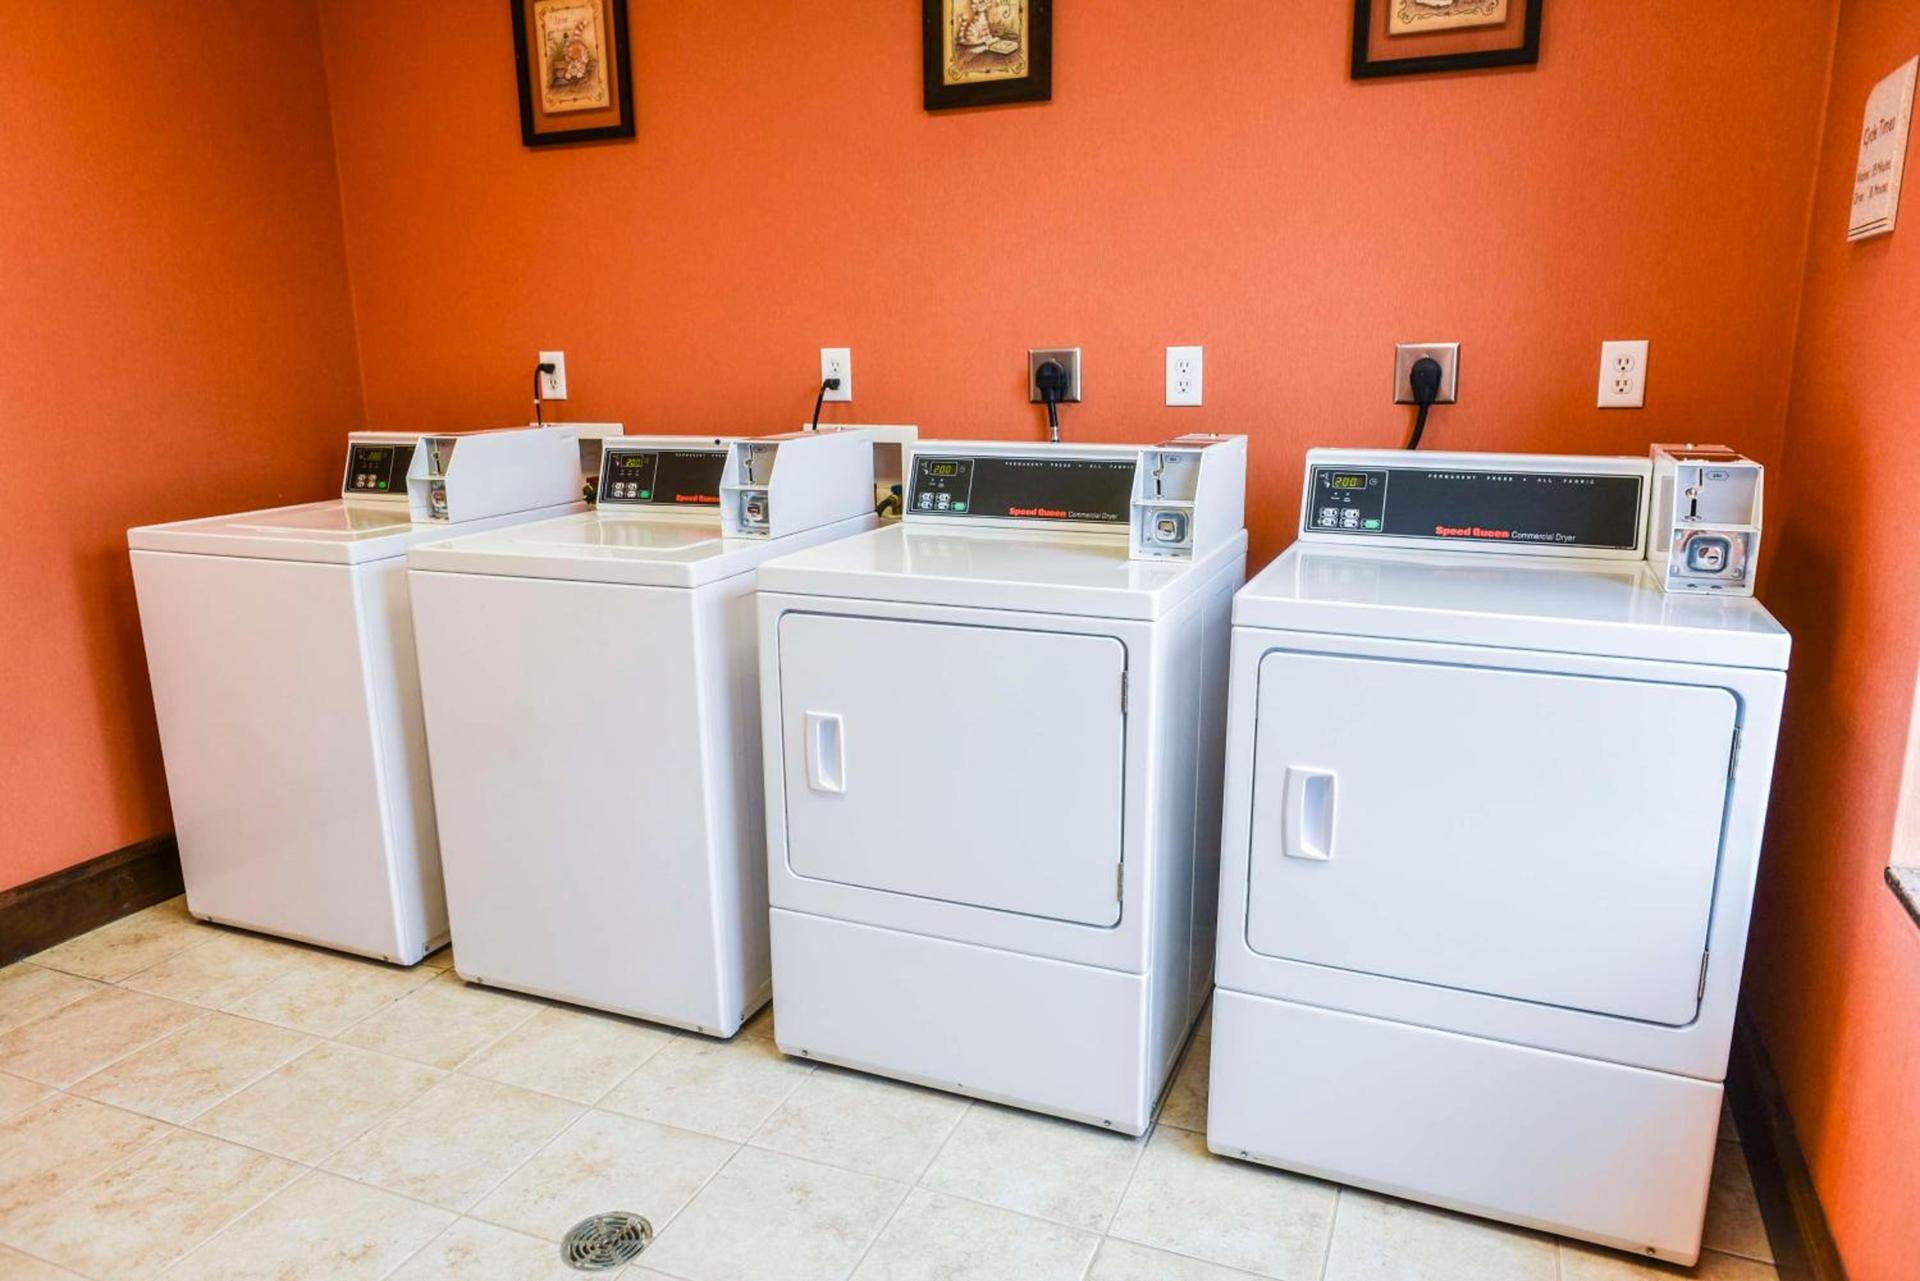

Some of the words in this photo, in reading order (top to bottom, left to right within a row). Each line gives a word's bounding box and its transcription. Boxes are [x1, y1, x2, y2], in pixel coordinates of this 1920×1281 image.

[933, 464, 952, 474] 200
[1335, 476, 1358, 487] 200
[1008, 507, 1037, 517] Speed
[1038, 508, 1067, 518] Queen
[1068, 511, 1101, 519] Commercial
[1102, 512, 1119, 520] Dryer
[1435, 525, 1472, 537] Speed
[1472, 527, 1510, 538] Queen
[1511, 530, 1554, 541] Commercial
[1555, 532, 1576, 543] Dryer
